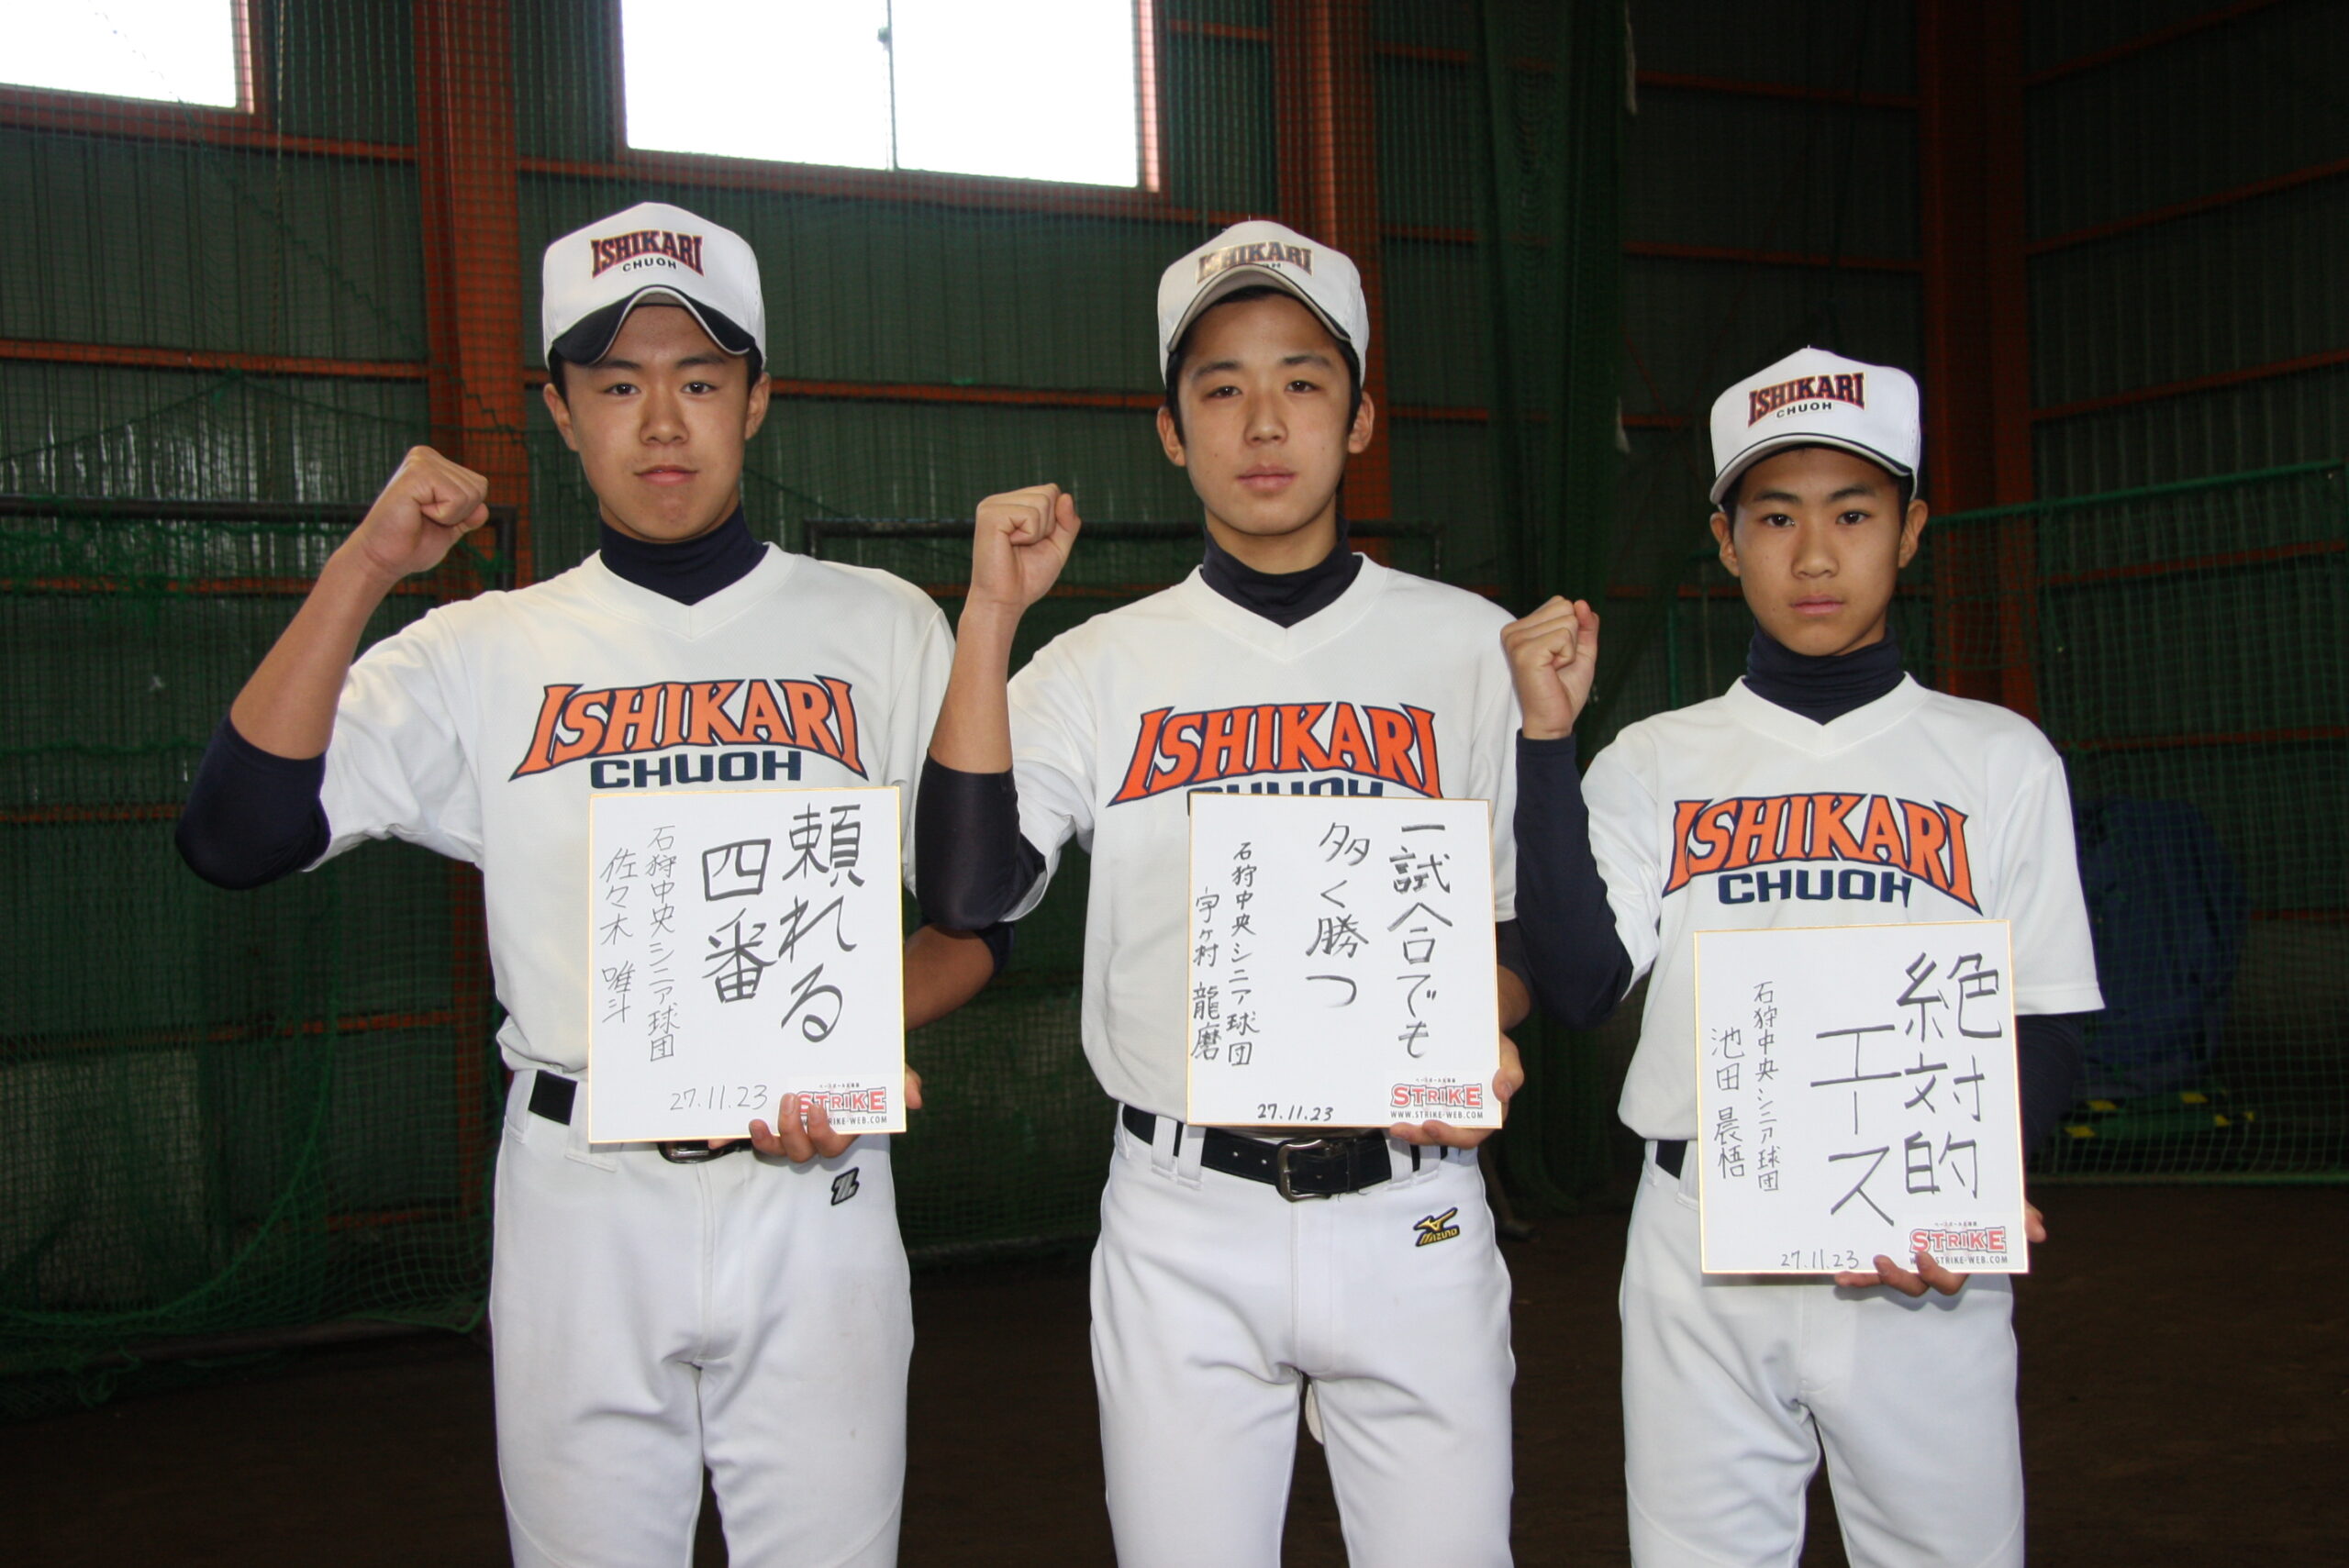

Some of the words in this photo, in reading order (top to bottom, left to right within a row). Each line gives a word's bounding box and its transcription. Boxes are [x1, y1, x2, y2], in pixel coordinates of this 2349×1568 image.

[590, 229, 705, 279] ISHIKARI
[623, 257, 677, 272] CHUOH
[1747, 372, 1865, 428] ISHIKARI
[1776, 402, 1832, 418] CHUOH
[507, 673, 869, 783] ISHIKARI
[1105, 701, 1444, 808] ISHIKARI
[590, 751, 801, 789] CHUOH
[1662, 792, 1984, 917] ISHIKARI
[1306, 821, 1371, 1008] 多く勝つ
[1718, 868, 1912, 908] CHUOH
[644, 825, 681, 1062] 石狩中央シニア球団
[701, 838, 778, 1004] 四番
[778, 802, 865, 1043] 頼れる
[1387, 824, 1453, 1059] 一試合でも
[1226, 841, 1261, 1066] 石狩中央シニア球団
[670, 1084, 768, 1110] 27.11.23
[797, 1086, 886, 1114] STRIKE
[1390, 1084, 1483, 1109] STRIKE
[1753, 981, 1781, 1192] 石狩中央シニア球団
[1896, 952, 2003, 1200] 絶対的
[1257, 1103, 1334, 1122] 27.11.23
[1390, 1110, 1483, 1119] WWW.STRIKE-WEB.COM
[1810, 1024, 1902, 1227] エース
[1780, 1249, 1859, 1270] 27.11.23
[1909, 1226, 2007, 1253] STRIKE
